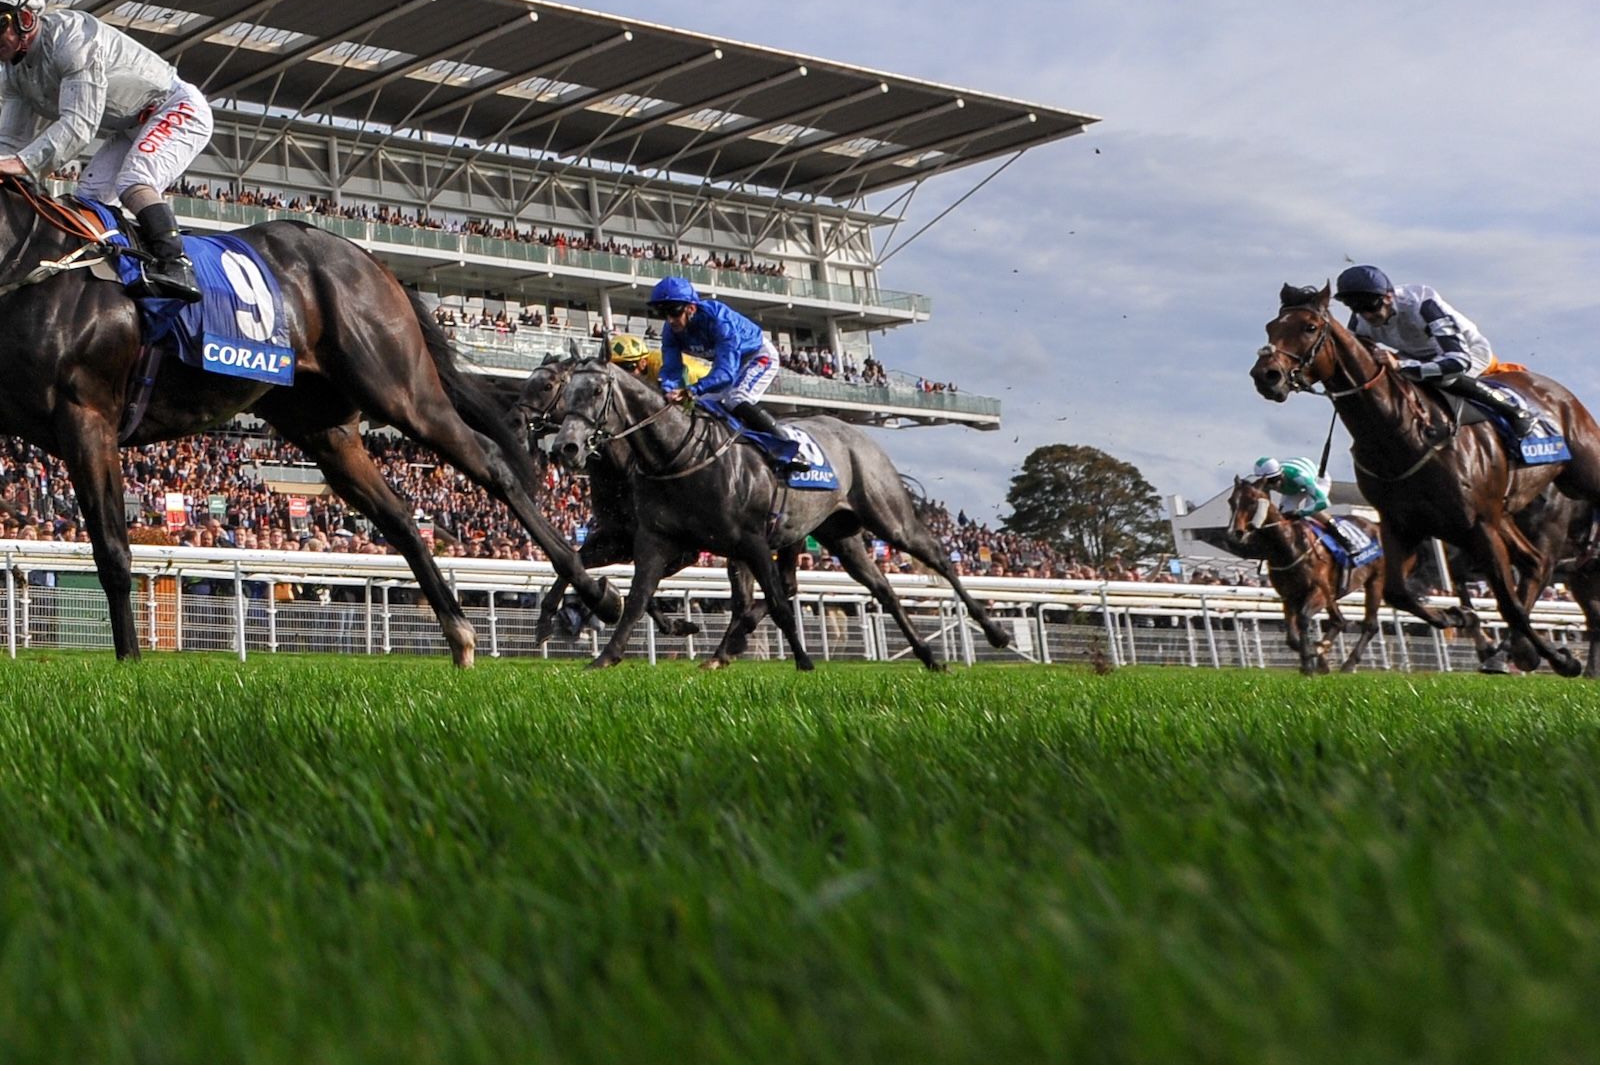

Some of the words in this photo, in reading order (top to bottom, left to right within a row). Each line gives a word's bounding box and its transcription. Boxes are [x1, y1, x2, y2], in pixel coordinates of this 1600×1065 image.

[138, 102, 195, 153] CITIPOT
[203, 343, 280, 373] CORAL
[1521, 443, 1559, 457] CORAL
